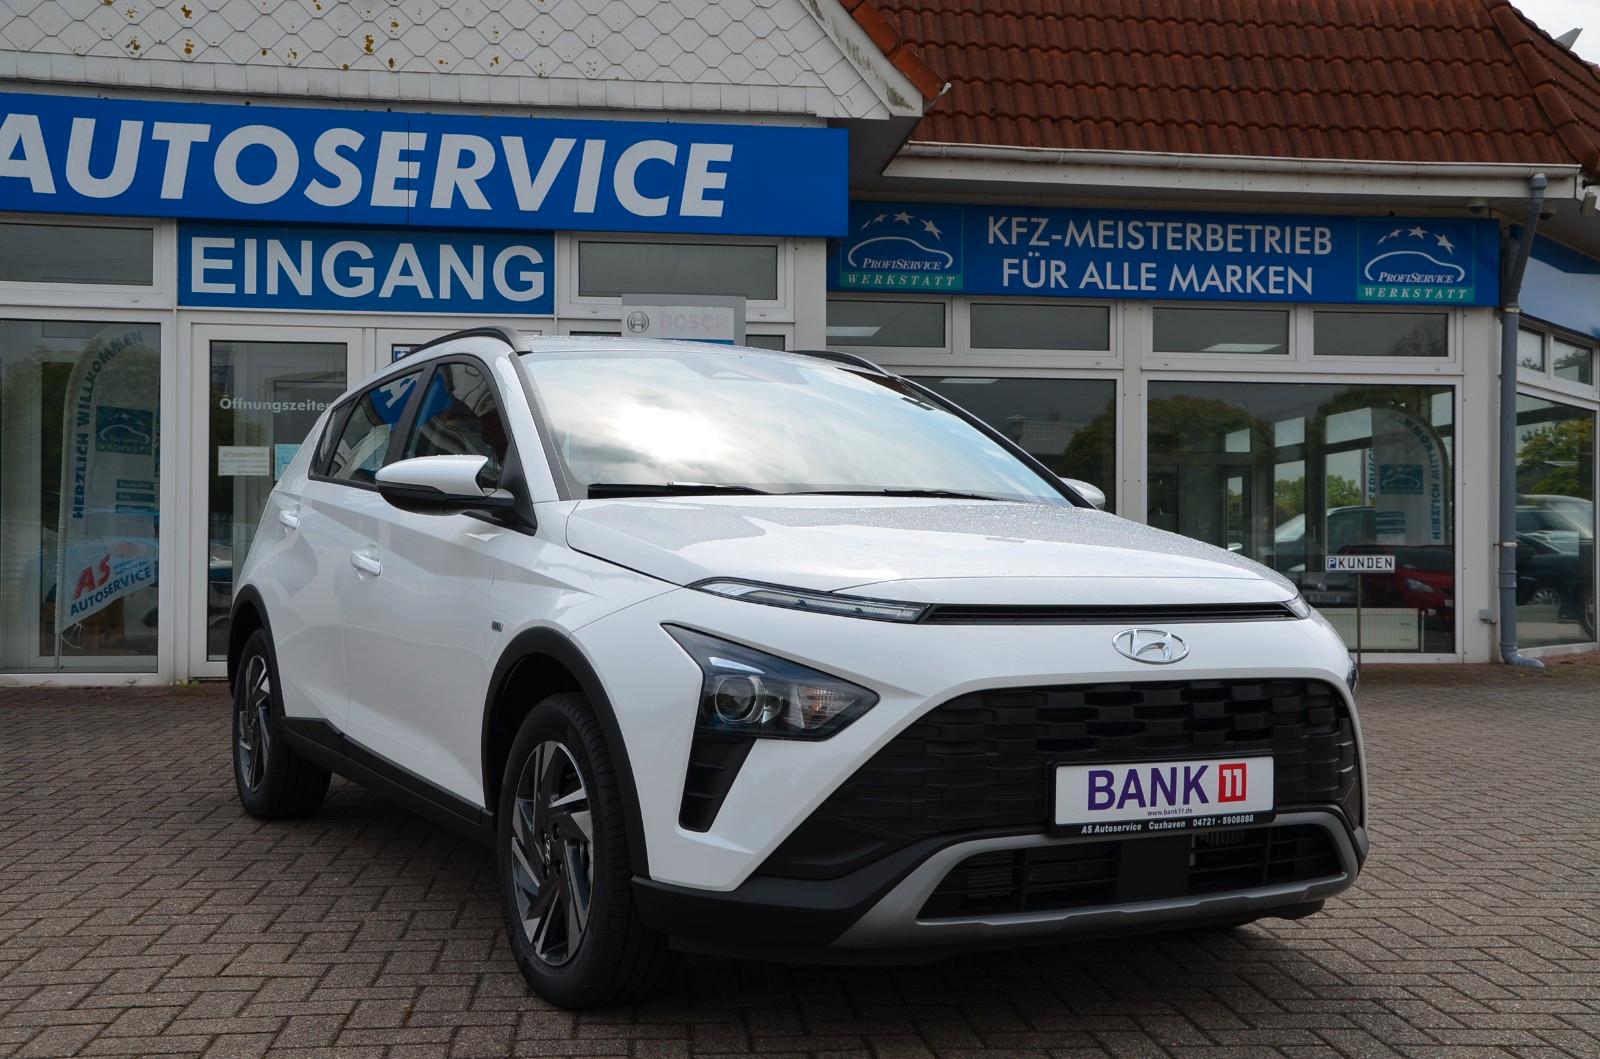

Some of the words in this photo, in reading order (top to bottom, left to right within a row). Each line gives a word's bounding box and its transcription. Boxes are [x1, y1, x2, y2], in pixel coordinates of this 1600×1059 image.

[0, 113, 734, 218] AUTOSERVICE
[987, 216, 1333, 255] KFZ-MEISTERBETRIEB
[191, 236, 545, 302] EINGANG
[848, 274, 955, 287] WERKSTATT
[1002, 252, 1068, 289] FÜR
[1079, 261, 1157, 291] ALLE
[1168, 263, 1313, 296] MARKEN
[1364, 287, 1467, 299] WERKSTATT
[659, 313, 727, 331] BOSCH
[76, 329, 144, 428] WILLKOMMEN
[72, 433, 89, 519] HERZLICH
[72, 554, 112, 600] AS
[1338, 557, 1393, 569] KUNDEN
[70, 567, 152, 617] AUTOSERVICE
[1087, 765, 1210, 811] BANK
[1222, 768, 1243, 798] 11
[1081, 825, 1093, 835] AS
[1094, 822, 1142, 834] Autoservice
[1148, 820, 1186, 831] Cuxhaven
[1193, 817, 1216, 827] 04721
[1147, 808, 1193, 817] www.bank11.de
